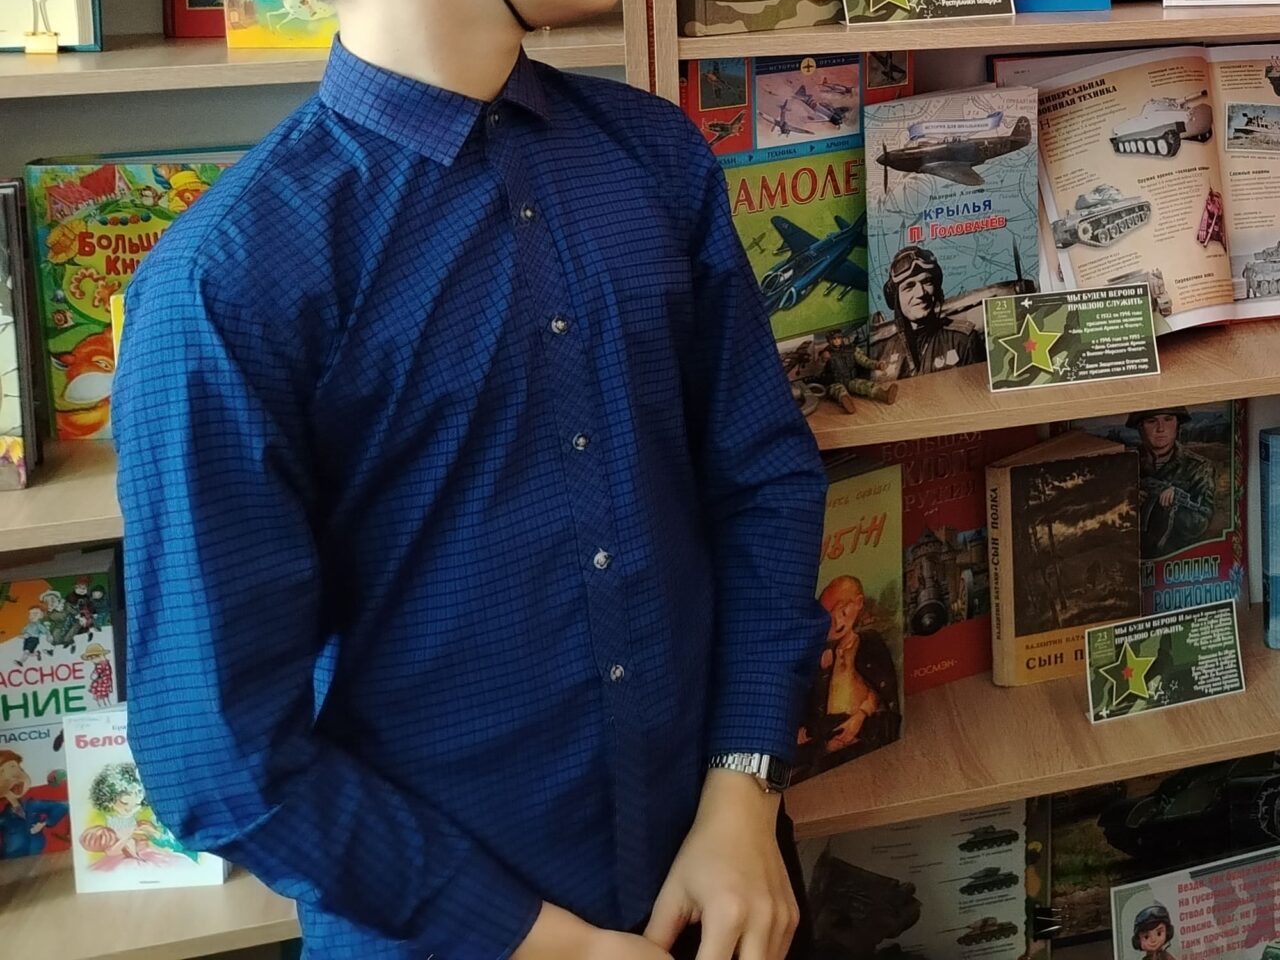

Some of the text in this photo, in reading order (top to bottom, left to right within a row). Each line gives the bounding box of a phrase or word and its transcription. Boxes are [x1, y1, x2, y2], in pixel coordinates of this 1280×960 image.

[1038, 79, 1105, 105] НИВЕРСАЛЬНАЯ
[1078, 85, 1117, 103] ТЕХНИКА
[727, 158, 864, 216] АМОЛЕ
[923, 200, 992, 221] КРЫЛЬЯ
[77, 230, 159, 256] БОЛЬШ
[995, 301, 1007, 310] 23
[1068, 299, 1143, 311] ПРАВДОЮ СЛУЖИТЬ
[1083, 292, 1107, 301] БУДЕМ
[1109, 290, 1135, 298] ВЕРОЮ
[1164, 555, 1220, 584] СОЛДАТ
[1115, 627, 1127, 635] МЫ
[1153, 616, 1177, 627] ВЕРОЮ
[1025, 652, 1064, 670] СЫН
[0, 660, 85, 688] АССНОЕ
[0, 685, 87, 723] НИЕ
